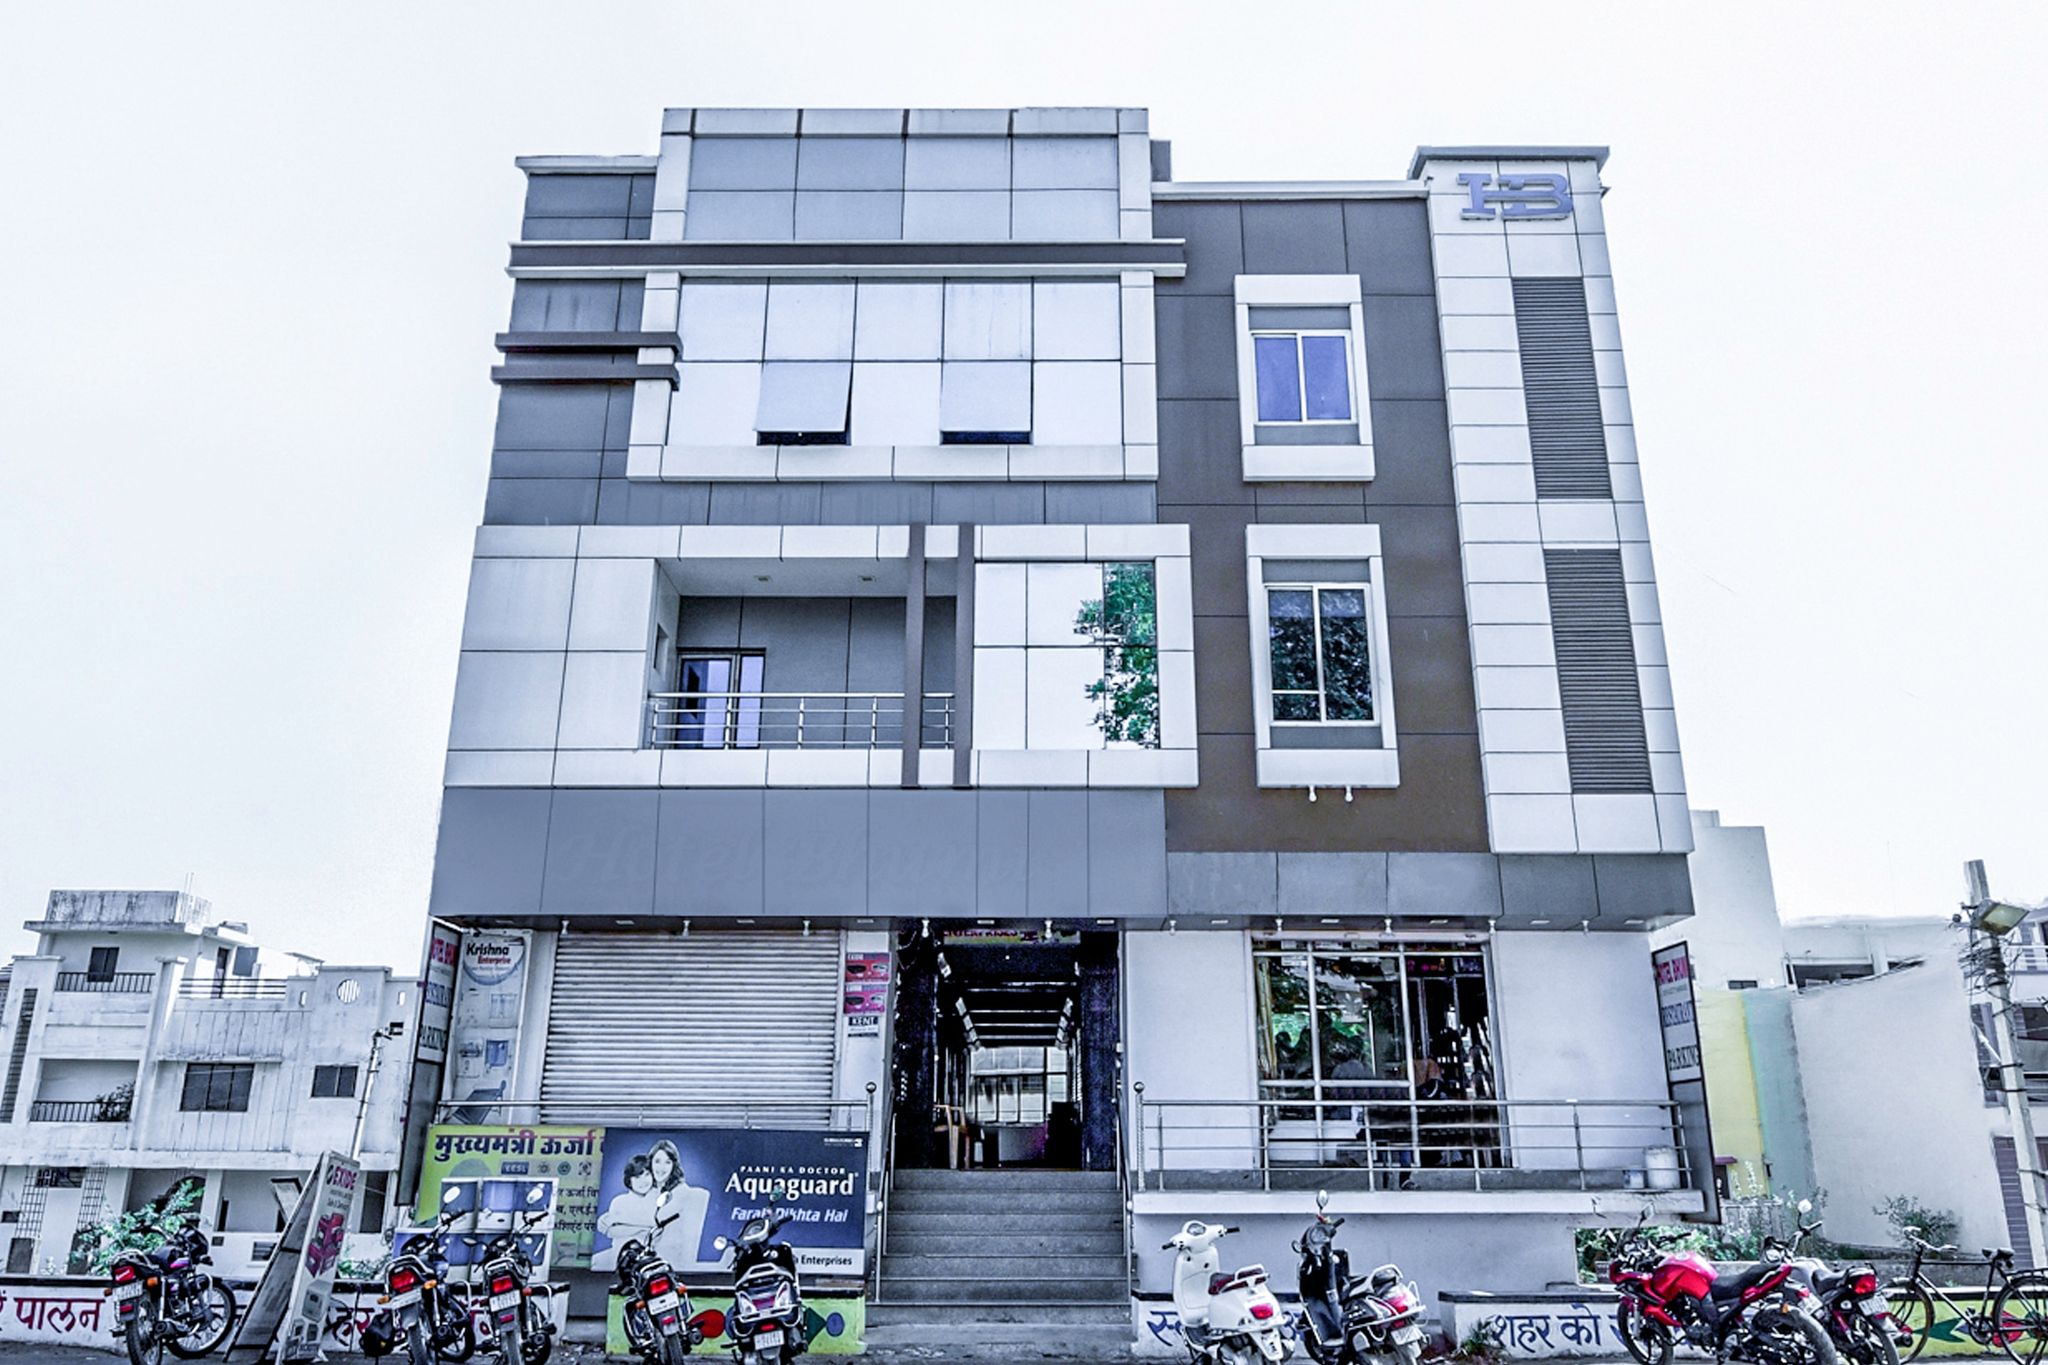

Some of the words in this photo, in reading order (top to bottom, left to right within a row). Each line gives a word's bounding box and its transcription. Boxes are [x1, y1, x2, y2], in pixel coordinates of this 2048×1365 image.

[466, 943, 509, 956] Krishna
[478, 956, 511, 965] Enterprise
[799, 1167, 846, 1175] DOCTOR
[824, 1209, 849, 1222] Hai
[801, 1255, 853, 1267] Enterprises
[13, 1297, 106, 1333] पालन
[1491, 1314, 1555, 1353] शहर
[1557, 1302, 1602, 1346] को
